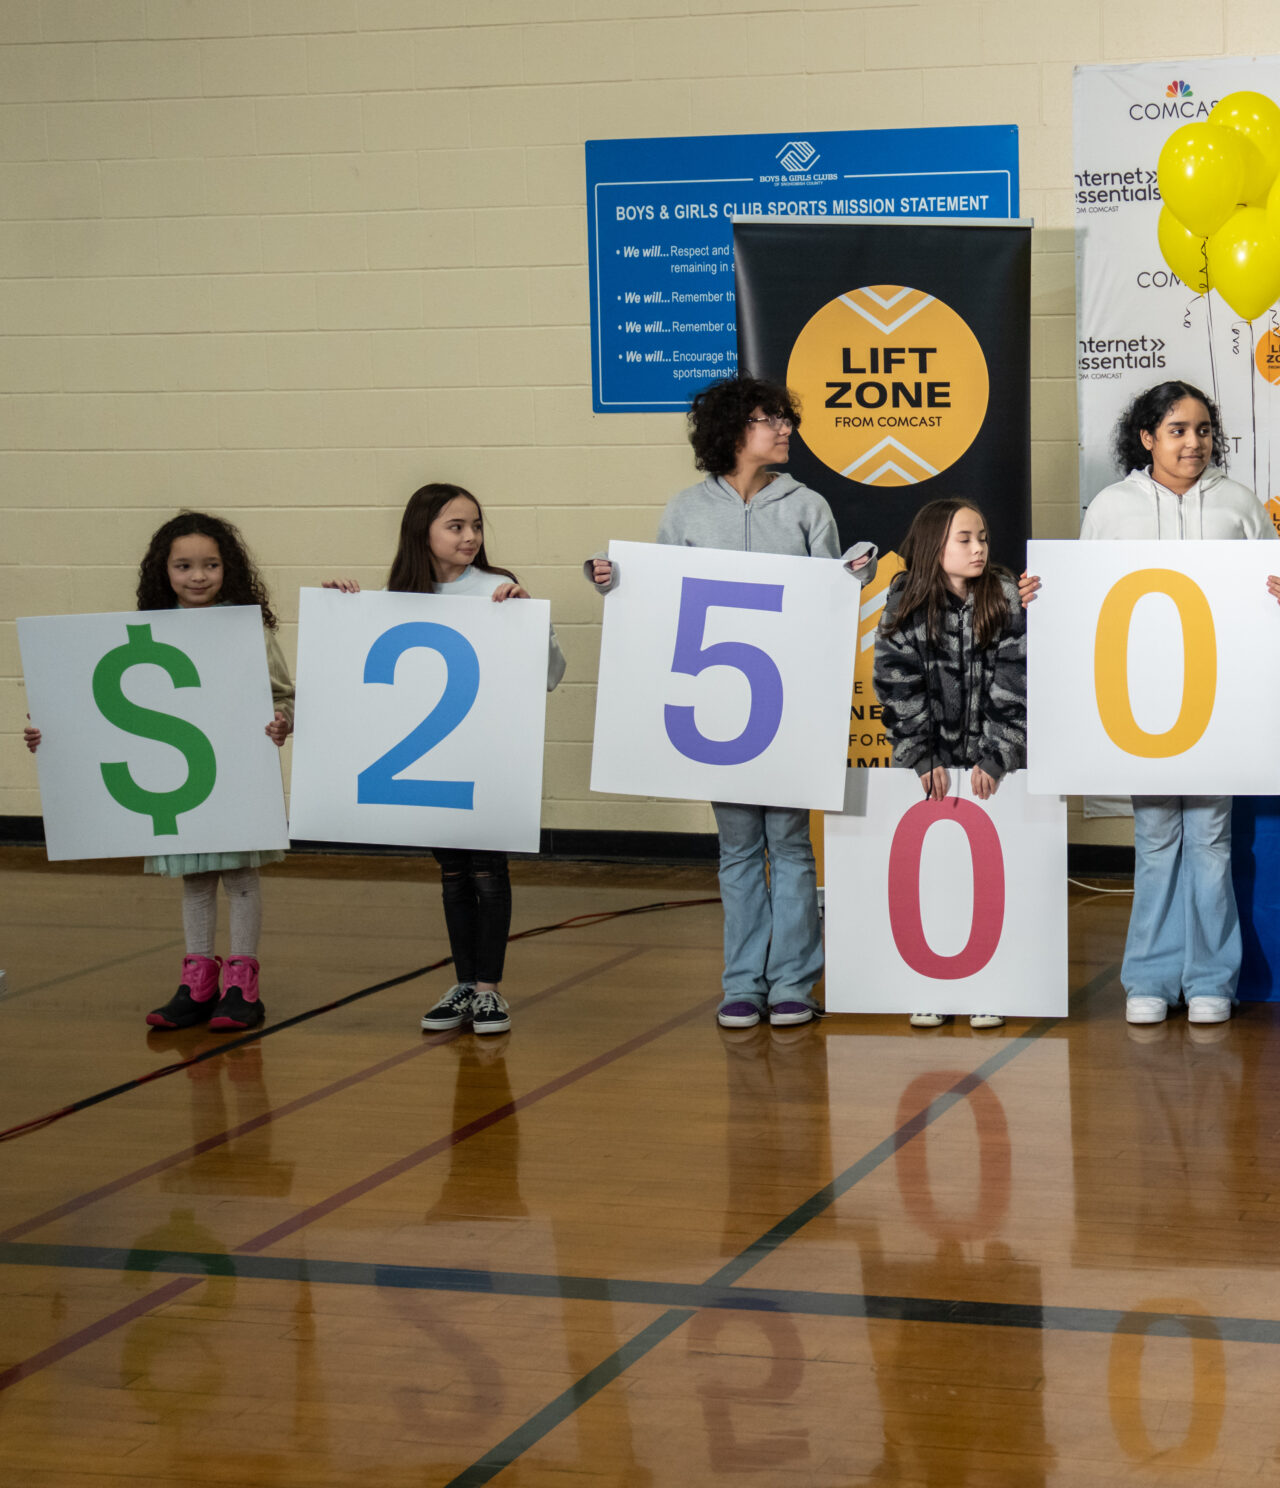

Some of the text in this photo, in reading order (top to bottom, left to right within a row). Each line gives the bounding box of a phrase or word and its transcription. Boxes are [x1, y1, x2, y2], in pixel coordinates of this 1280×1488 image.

[1129, 100, 1219, 121] COMCA
[760, 175, 780, 183] BOYS
[788, 174, 812, 182] GIRLS
[813, 173, 838, 181] CLUBS
[1074, 168, 1143, 187] nternet
[1075, 184, 1161, 204] ssentials
[616, 206, 654, 221] BOYS
[659, 204, 670, 220] &
[674, 203, 718, 219] GIRLS
[768, 200, 828, 216] SPORTS
[832, 198, 895, 215] MISSION
[900, 195, 989, 213] STATEMENT
[623, 246, 640, 258] We
[642, 245, 670, 258] will...
[670, 245, 709, 259] Respect
[712, 245, 730, 256] and
[670, 262, 717, 275] remaining
[719, 261, 729, 272] in
[625, 292, 641, 304] We
[643, 291, 670, 304] will...
[671, 291, 724, 303] Remember
[625, 321, 642, 333] We
[644, 321, 671, 333] will...
[672, 321, 724, 332] Remember
[1079, 335, 1148, 353] nternet
[626, 351, 642, 363] We
[645, 350, 672, 363] will...
[672, 351, 724, 364] Encourage
[842, 347, 938, 375] LIFT
[825, 381, 952, 409] ZONE
[834, 415, 942, 428] FROM COMCAST
[663, 576, 784, 766] 5
[1093, 568, 1218, 759] 0
[357, 620, 481, 811] 2
[92, 624, 217, 836] $
[887, 795, 1005, 980] 0
